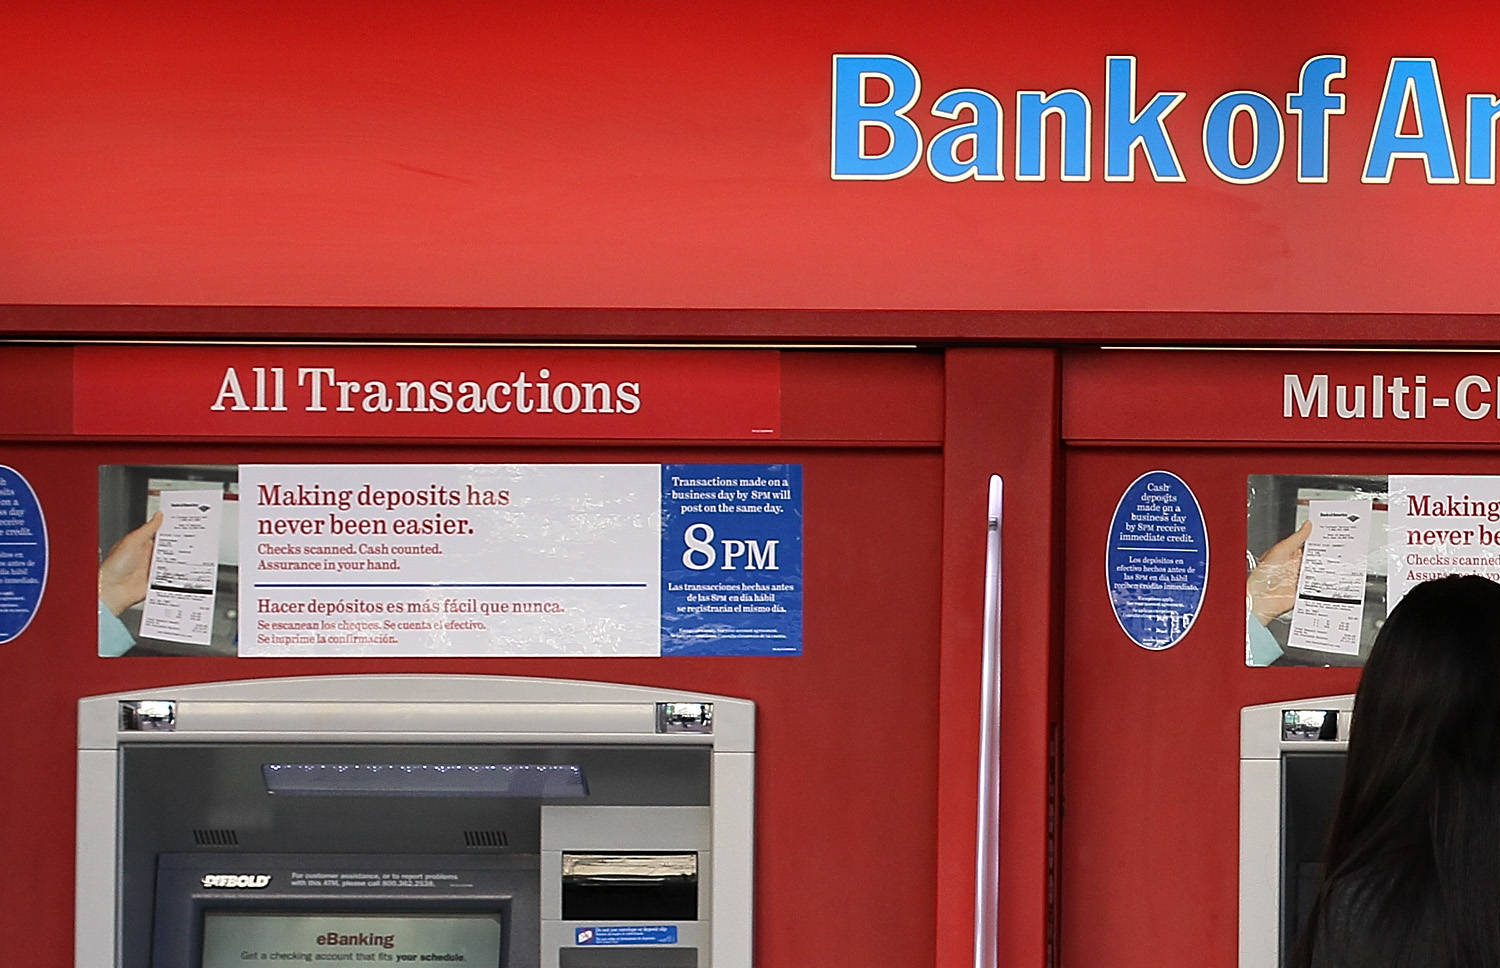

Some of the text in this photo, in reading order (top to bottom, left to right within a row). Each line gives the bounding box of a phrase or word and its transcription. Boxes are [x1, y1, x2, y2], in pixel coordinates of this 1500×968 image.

[829, 52, 1188, 184] Bank
[1201, 53, 1351, 184] of
[211, 368, 640, 413] All Transactions
[672, 477, 738, 486] Transactions
[740, 477, 767, 486] made
[258, 485, 509, 511] Making deposits has
[672, 490, 790, 501] business day by 8PM will
[681, 504, 702, 514] post
[718, 503, 734, 512] the
[764, 503, 783, 514] day.
[258, 513, 473, 534] never been easier.
[1407, 530, 1474, 546] never
[258, 544, 442, 554] Checks scanned. Cash counted.
[683, 524, 779, 569] 8 PM
[258, 559, 400, 572] Assurance in your hand.
[1407, 554, 1449, 565] Checks
[257, 598, 565, 616] Hacer depósitos es más fácil que nunca.
[202, 875, 271, 887] DIEBOLD
[317, 932, 394, 948] eBanking
[240, 952, 258, 960] Get
[270, 952, 312, 962] checking
[396, 954, 417, 962] your
[420, 953, 467, 962] schedule.
